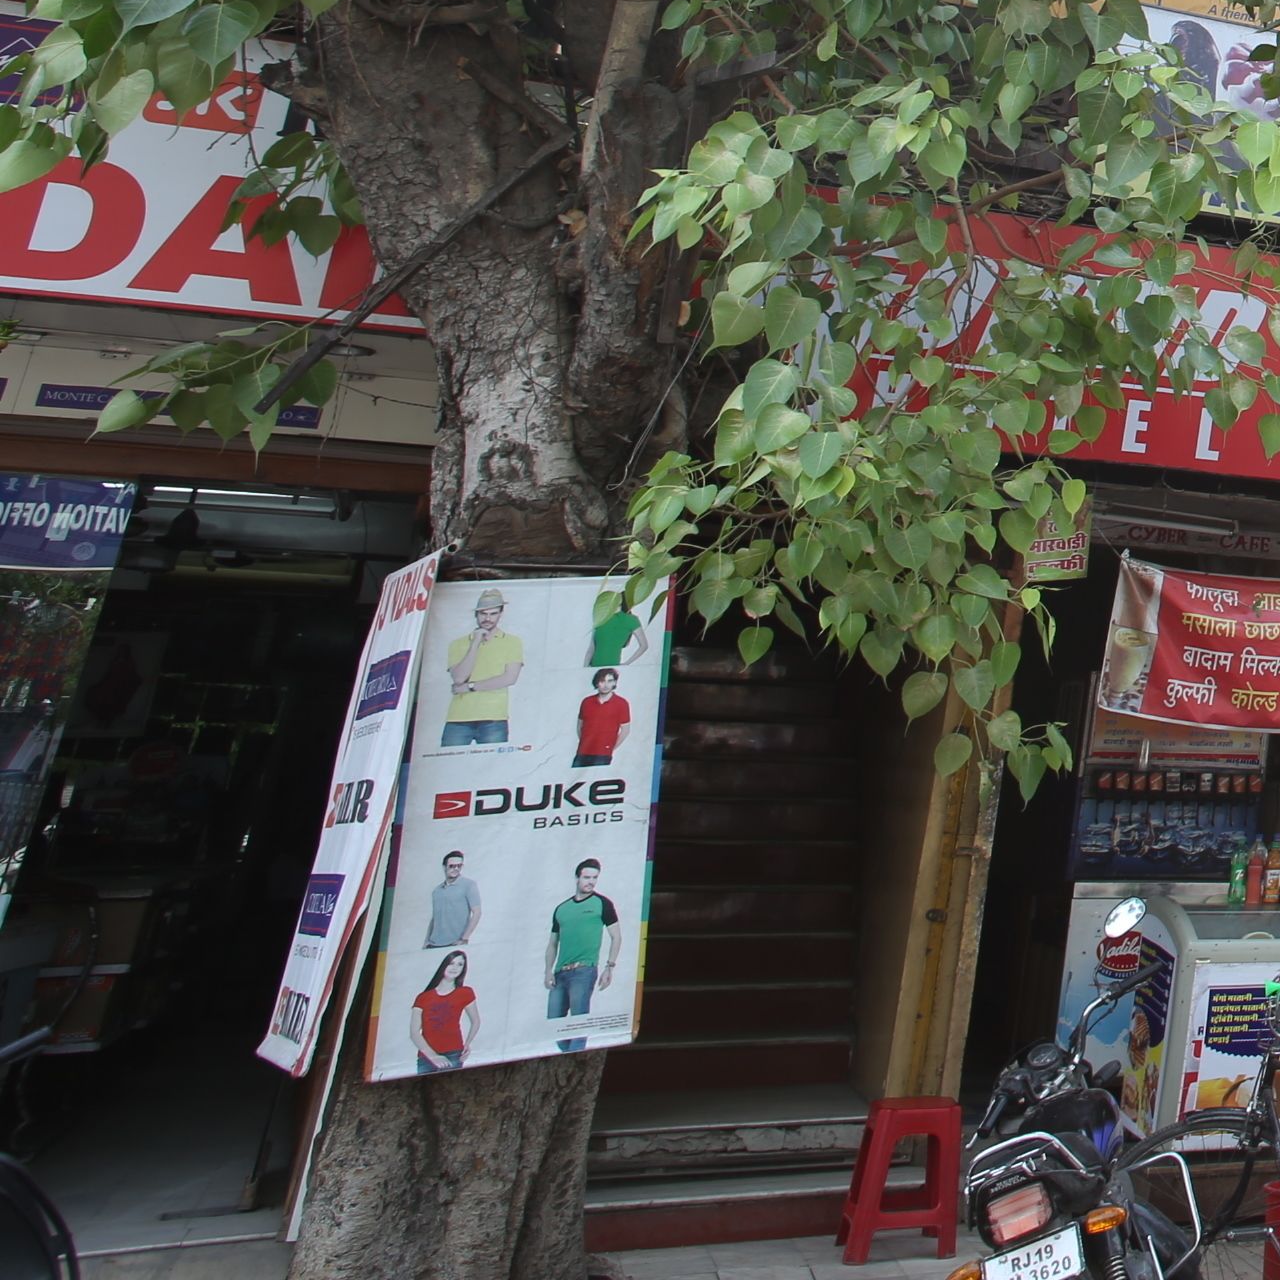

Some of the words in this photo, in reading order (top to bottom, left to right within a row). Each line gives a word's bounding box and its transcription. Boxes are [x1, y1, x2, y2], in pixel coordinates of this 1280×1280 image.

[46, 388, 95, 404] MONTE
[1128, 525, 1187, 546] CYBER
[1219, 533, 1272, 554] CAFE
[1183, 646, 1234, 674] बादाम
[533, 810, 625, 830] BASICS
